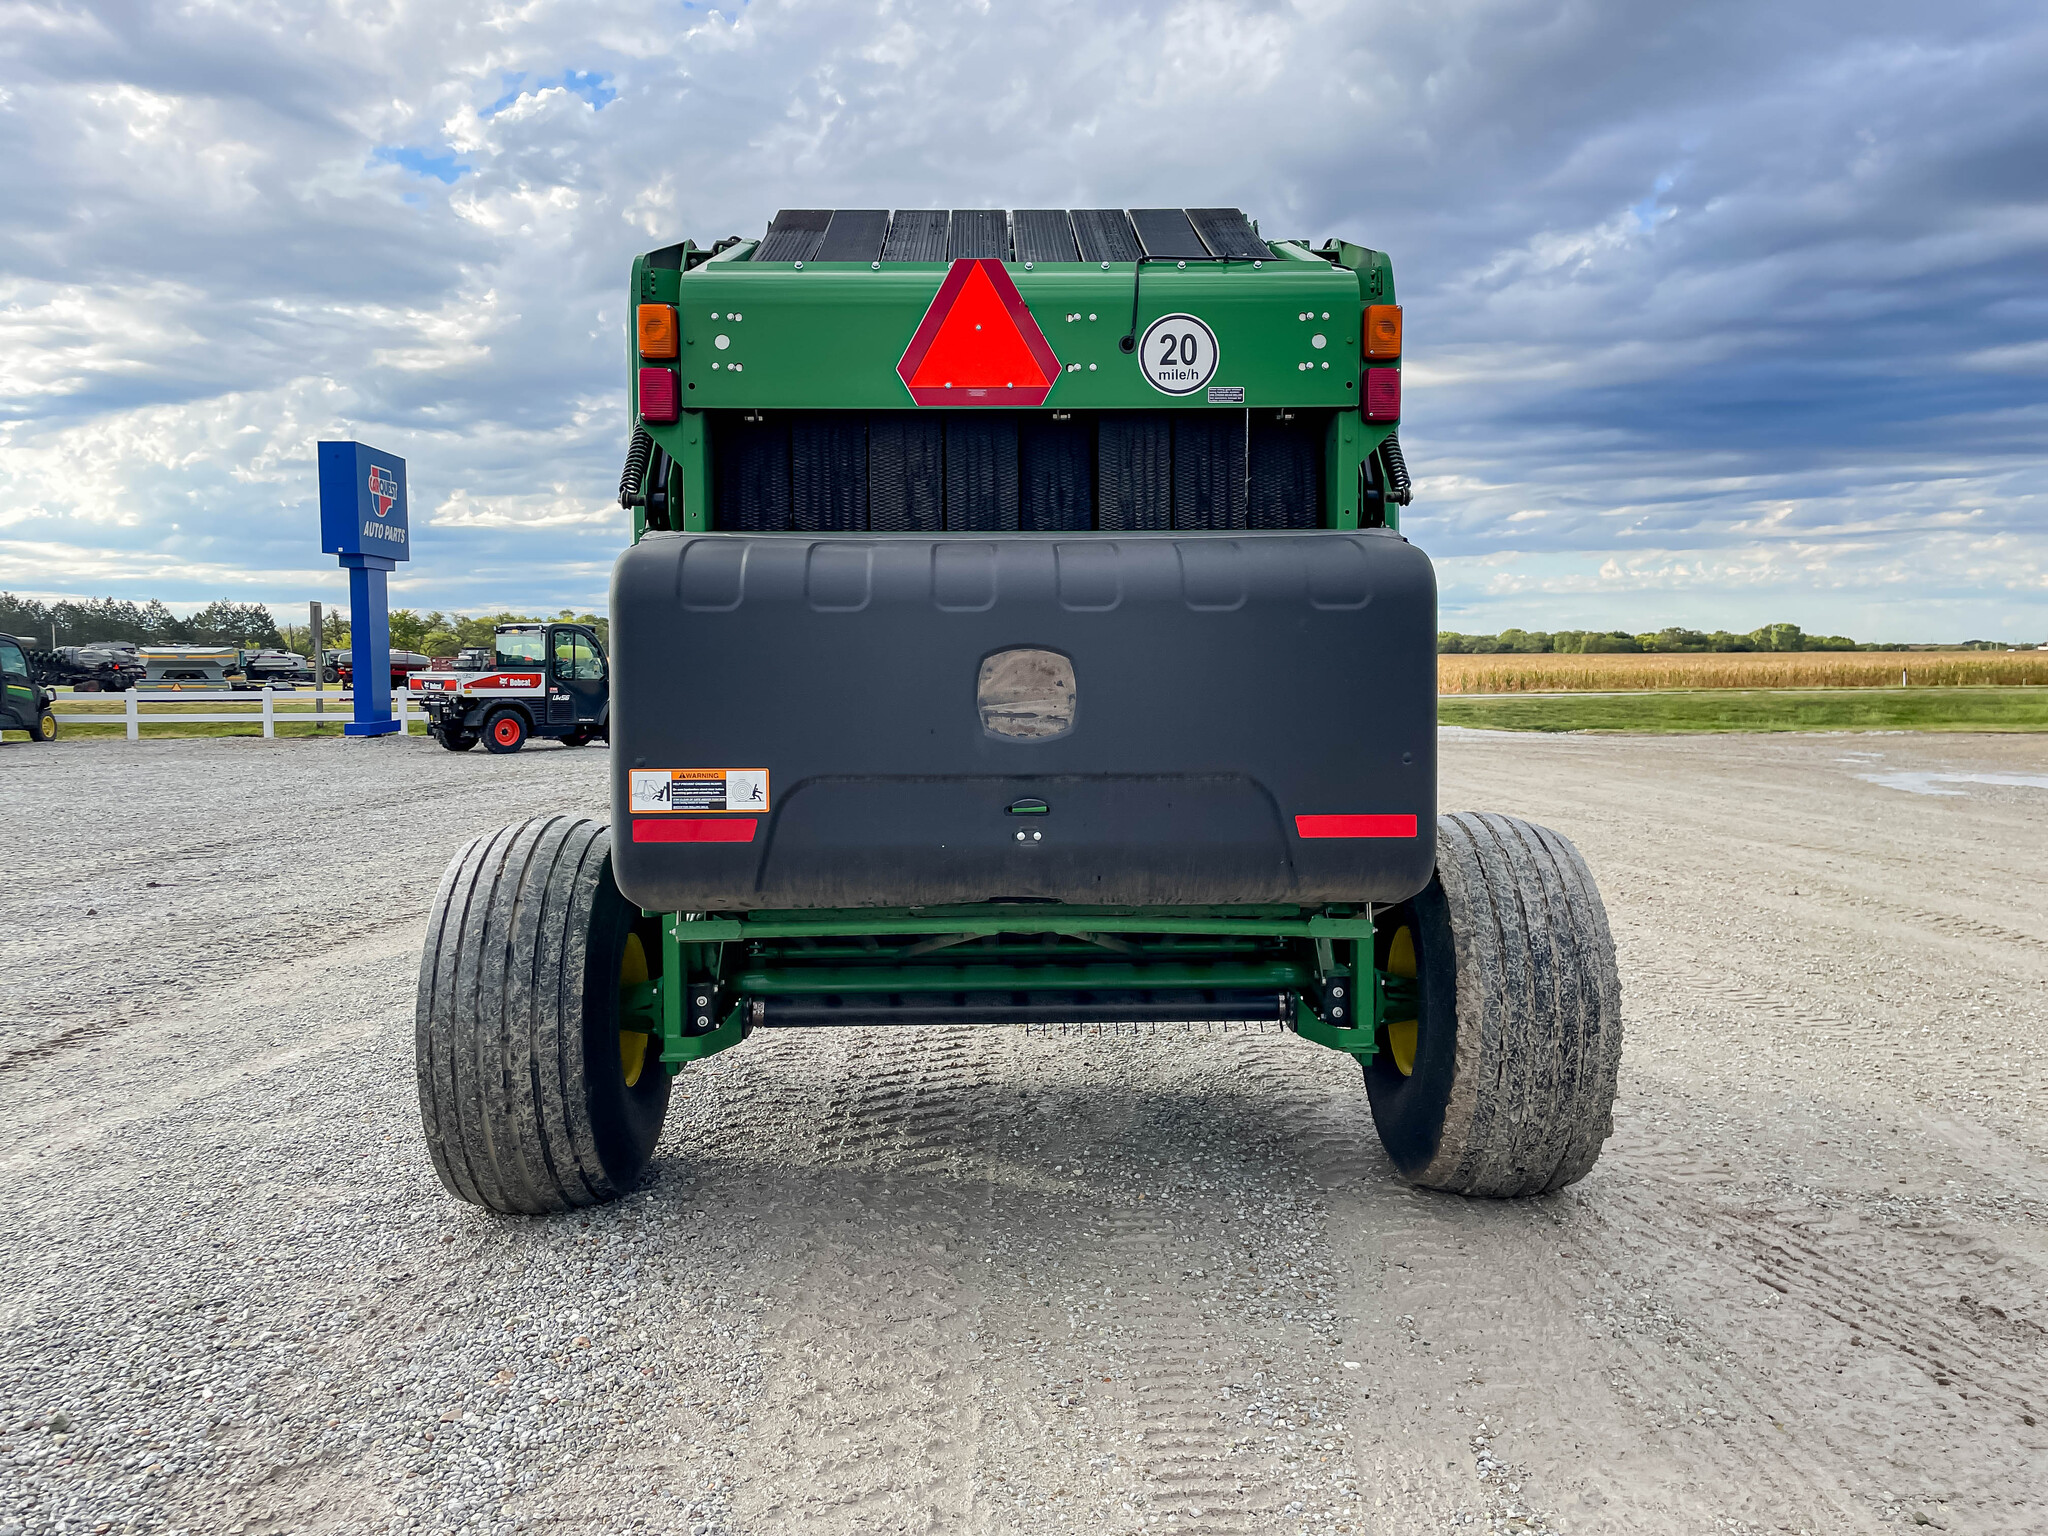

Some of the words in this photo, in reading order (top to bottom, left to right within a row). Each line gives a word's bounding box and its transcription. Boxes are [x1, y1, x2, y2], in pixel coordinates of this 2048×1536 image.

[1159, 333, 1198, 366] 20
[1158, 368, 1199, 381] mile/h
[363, 520, 384, 539] AUTO
[384, 525, 406, 544] PARTS
[509, 678, 531, 687] Bobcat
